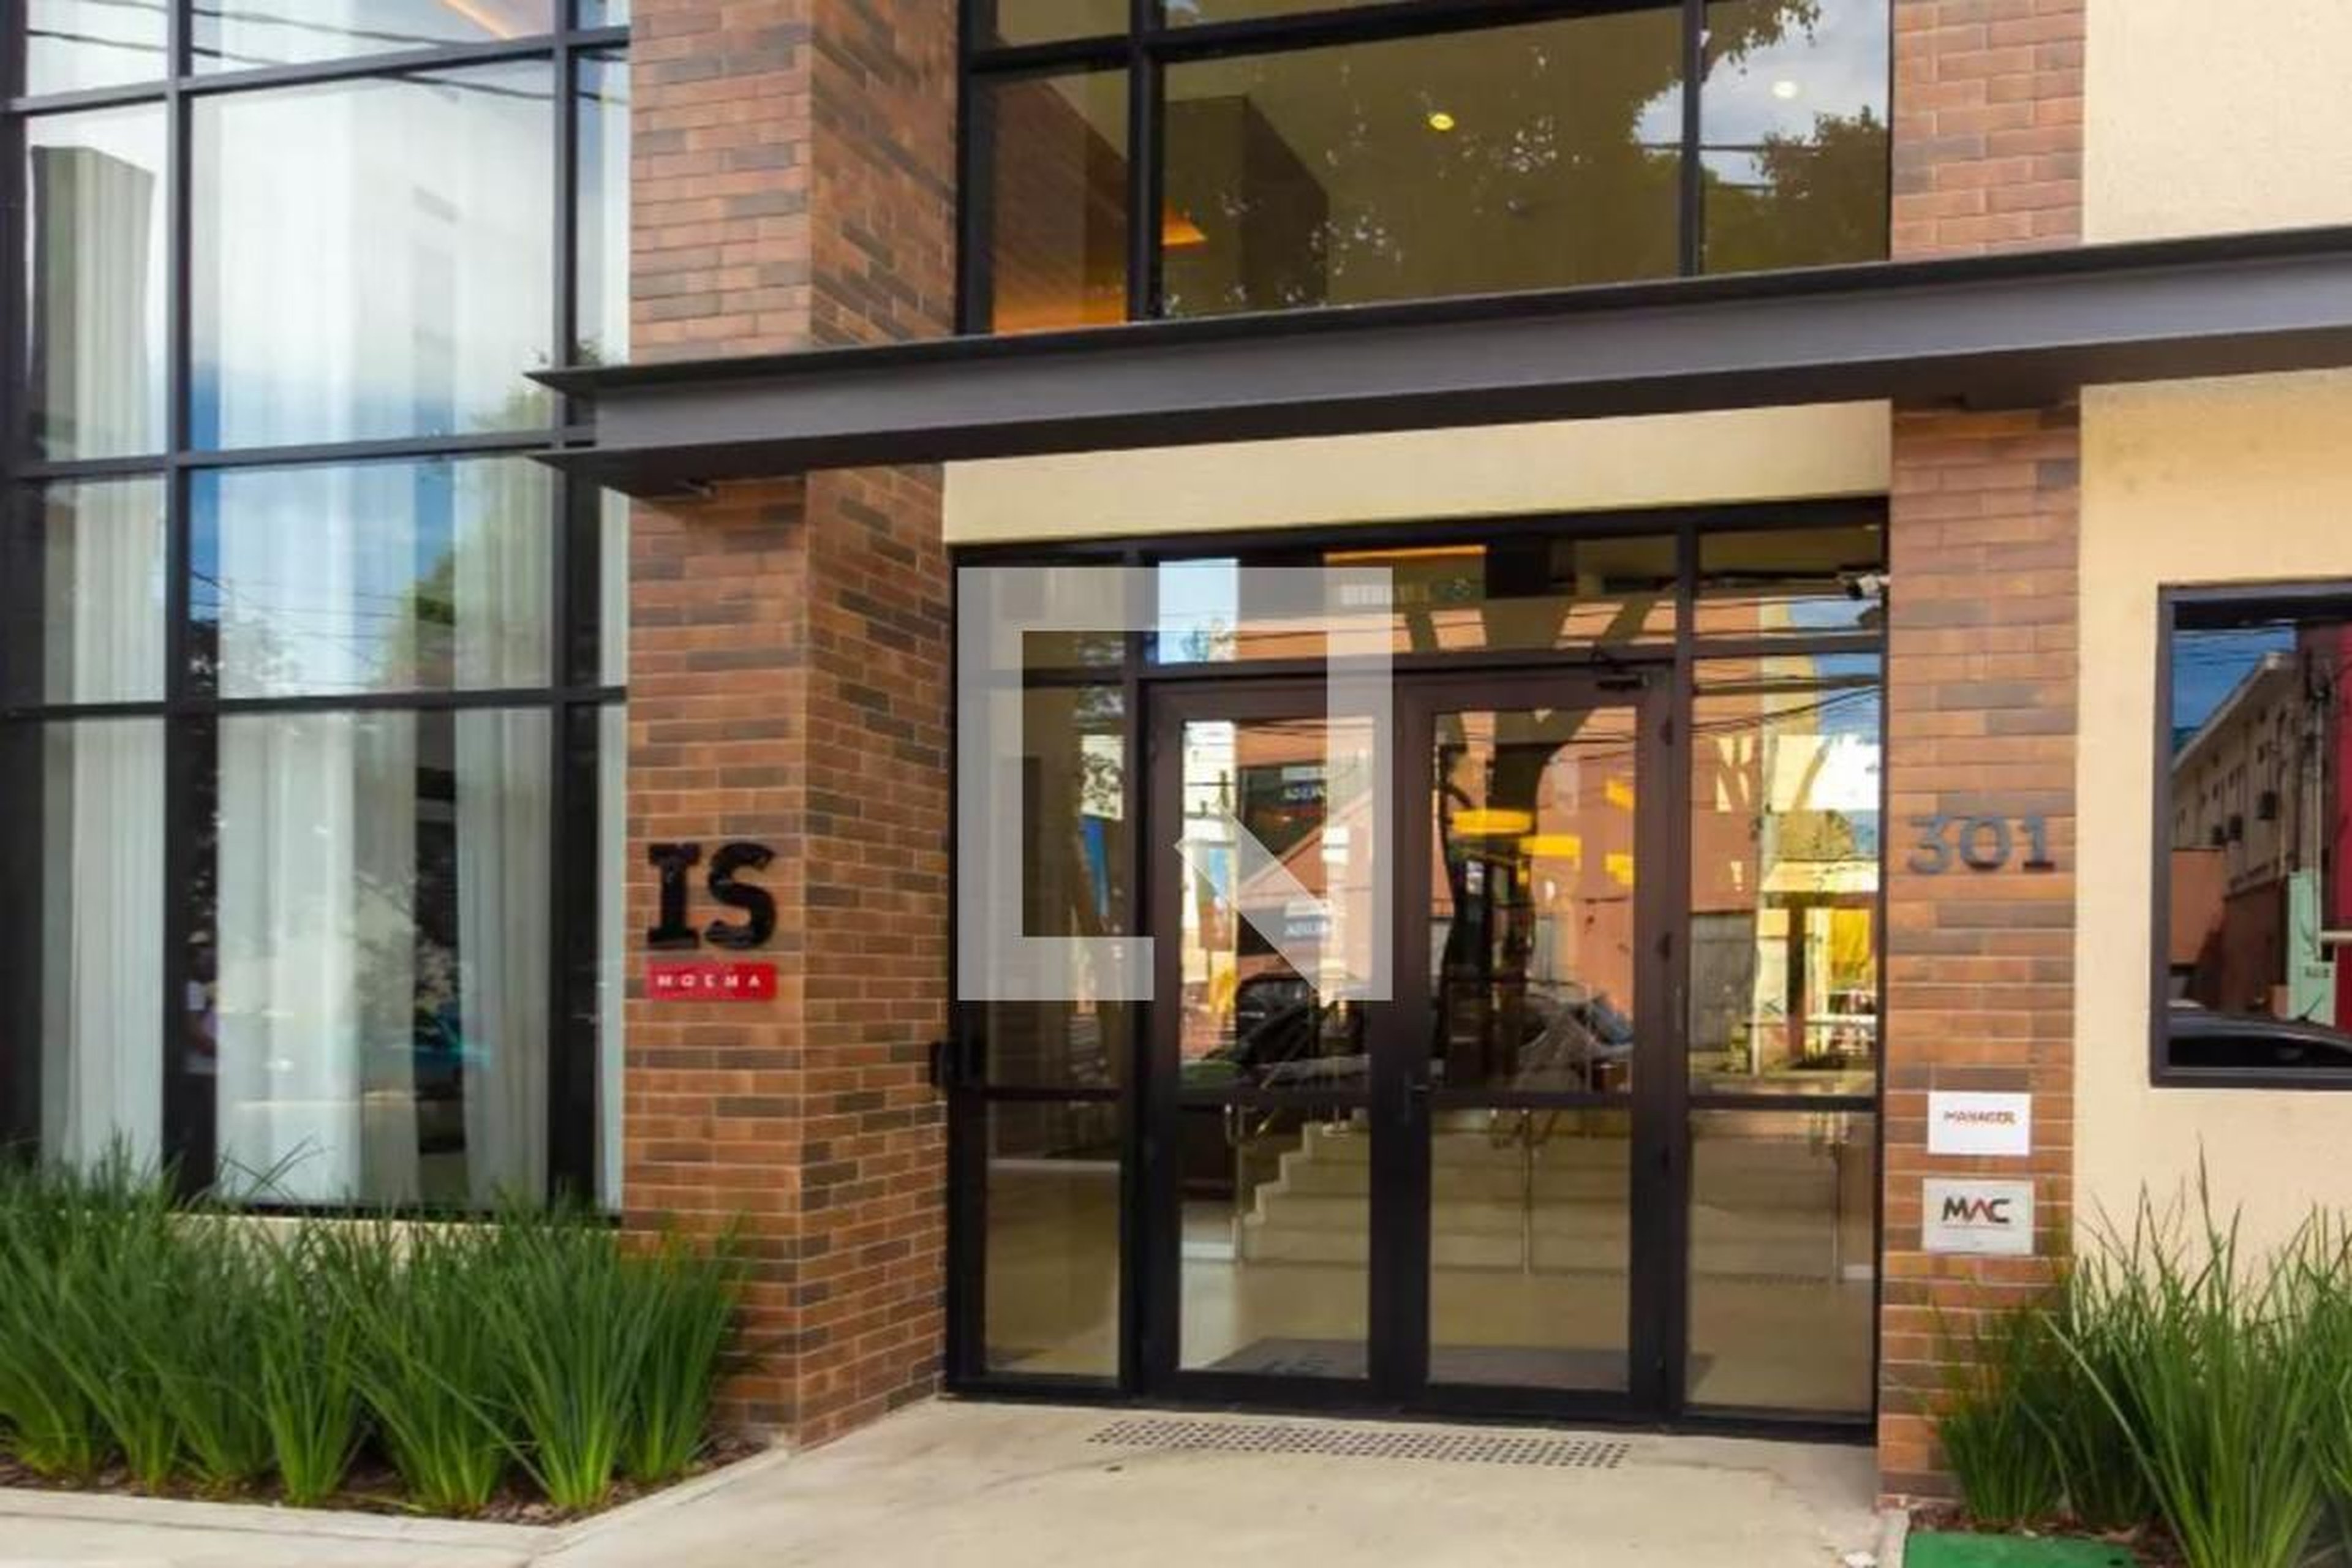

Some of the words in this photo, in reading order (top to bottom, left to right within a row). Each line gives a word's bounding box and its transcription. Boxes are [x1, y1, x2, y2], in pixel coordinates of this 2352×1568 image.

[1907, 816, 2056, 874] 301
[647, 843, 777, 949] IS
[1942, 1196, 2010, 1224] MAC
